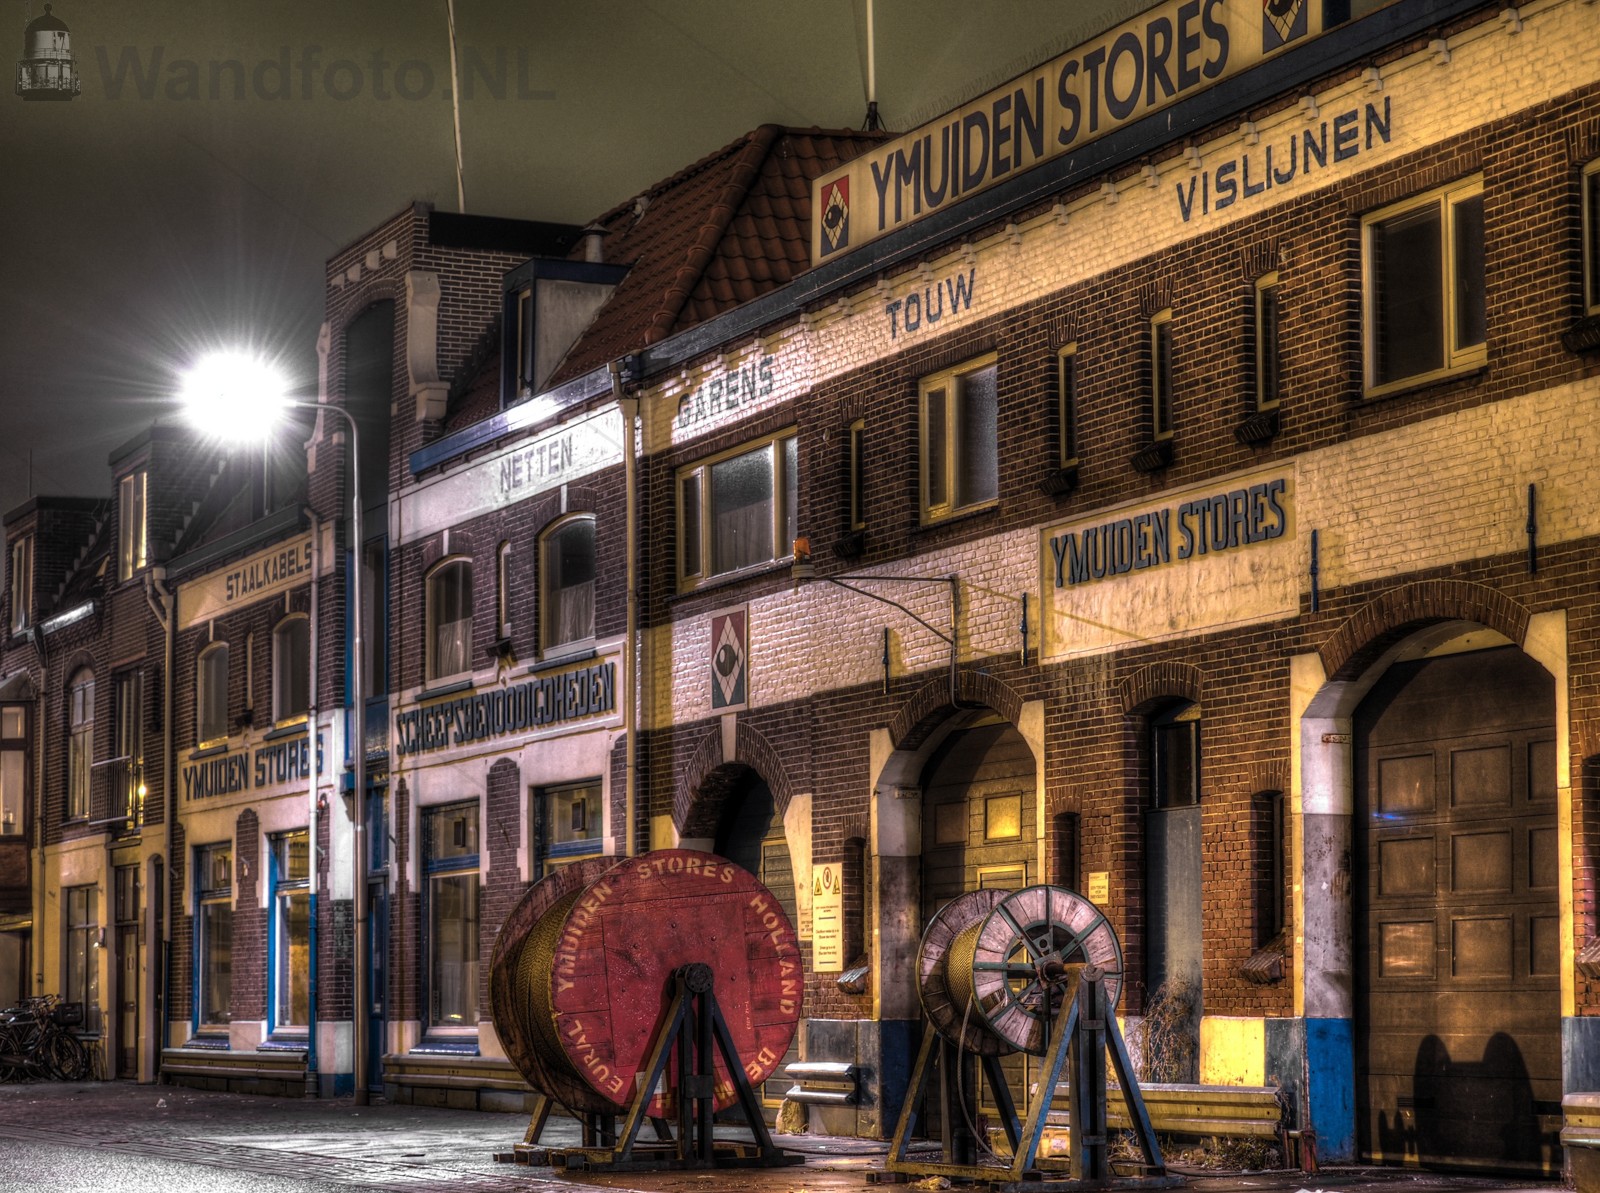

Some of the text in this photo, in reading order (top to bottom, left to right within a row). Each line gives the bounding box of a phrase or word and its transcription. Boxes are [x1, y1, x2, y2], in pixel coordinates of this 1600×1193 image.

[870, 0, 1230, 231] YMUIDEN STORES
[1176, 96, 1391, 222] VISLIJNEN
[886, 268, 975, 339] TOUW
[678, 356, 773, 428] GARENS
[500, 433, 573, 494] NETTEN
[226, 541, 312, 601] STAALKABELS
[1050, 478, 1286, 588] YMUIDEN STORES
[396, 662, 615, 756] SCHEEPSBENOODIGDHEDEN
[183, 752, 248, 801] YMUIDEN
[557, 857, 797, 1015] YMUIDEN STORES HOLLAND
